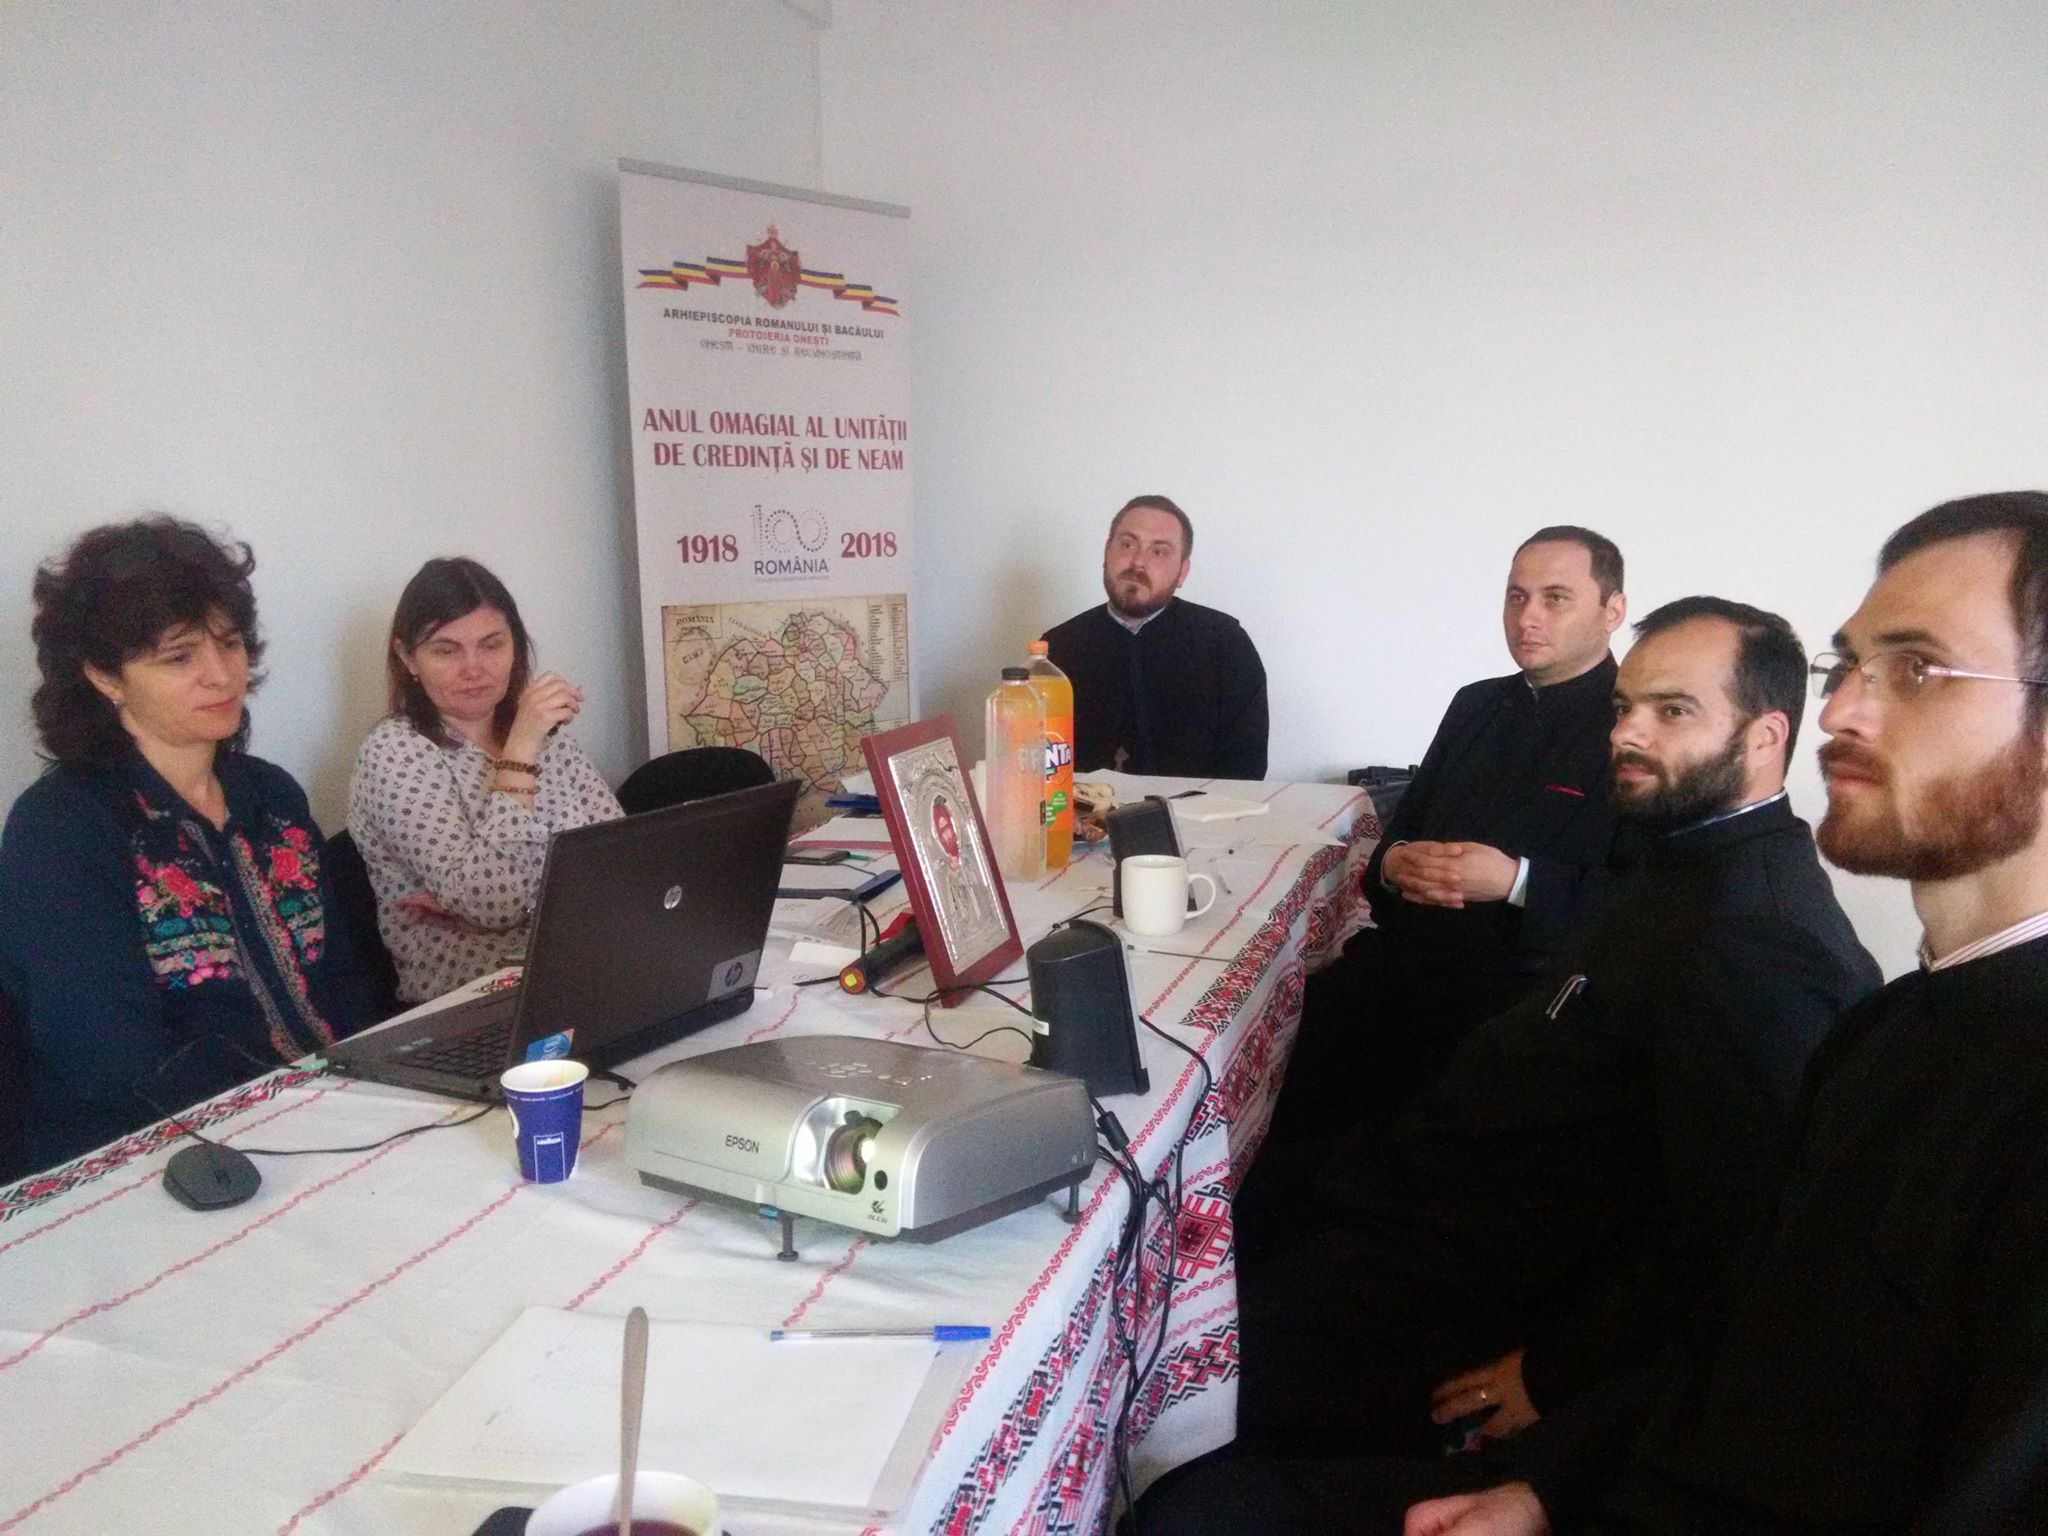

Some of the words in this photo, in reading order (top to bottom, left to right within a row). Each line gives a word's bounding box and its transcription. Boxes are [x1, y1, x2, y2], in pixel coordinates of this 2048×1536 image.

[663, 308, 752, 326] ARHIEPISCOPIA
[755, 317, 818, 333] ROMANULUI
[728, 328, 791, 343] PROTOIERIA
[643, 408, 704, 433] ANUL
[709, 411, 800, 437] OMAGIAL
[805, 416, 829, 438] AL
[654, 443, 686, 466] DE
[826, 448, 852, 469] DE
[858, 449, 904, 470] NEAM
[676, 534, 739, 564] 1918
[840, 531, 898, 558] 2018
[754, 555, 830, 575] ROMÂNIA
[725, 1134, 760, 1154] EPSON
